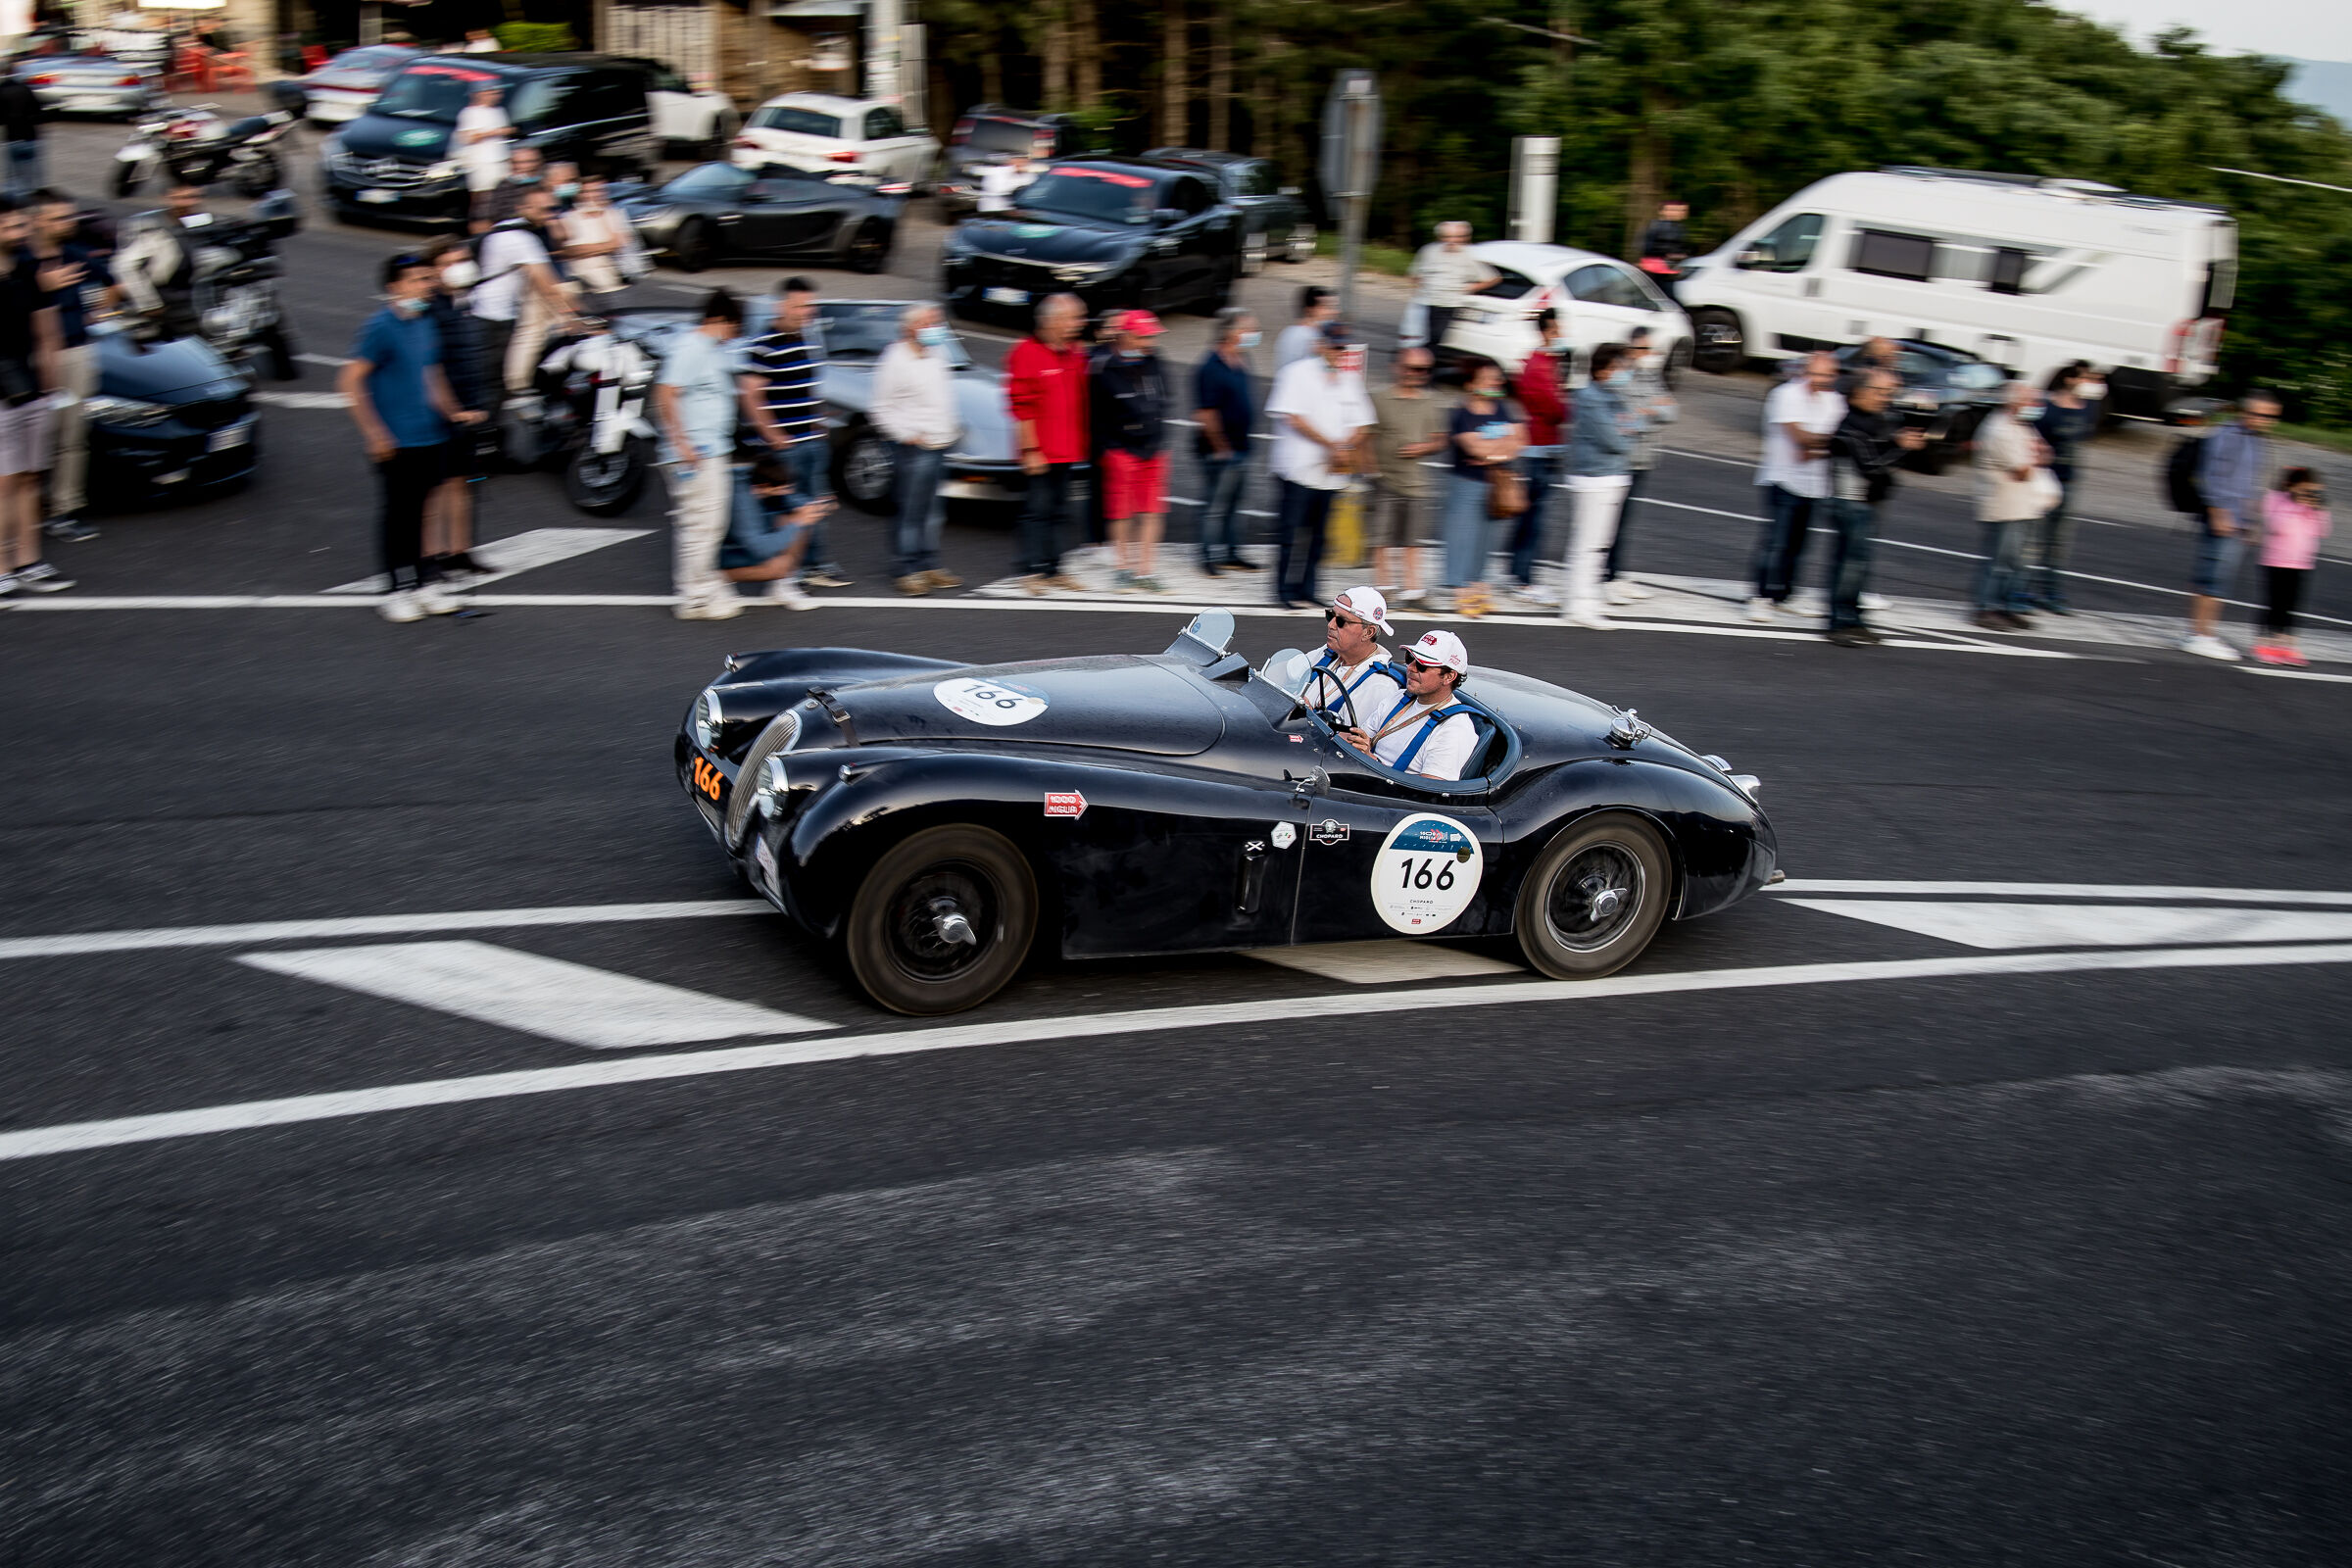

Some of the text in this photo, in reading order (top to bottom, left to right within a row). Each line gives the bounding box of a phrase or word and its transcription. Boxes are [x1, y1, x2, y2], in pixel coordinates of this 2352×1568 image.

[963, 684, 1023, 709] 166
[694, 756, 724, 801] 166
[1050, 795, 1077, 804] 1000
[1400, 858, 1455, 891] 166
